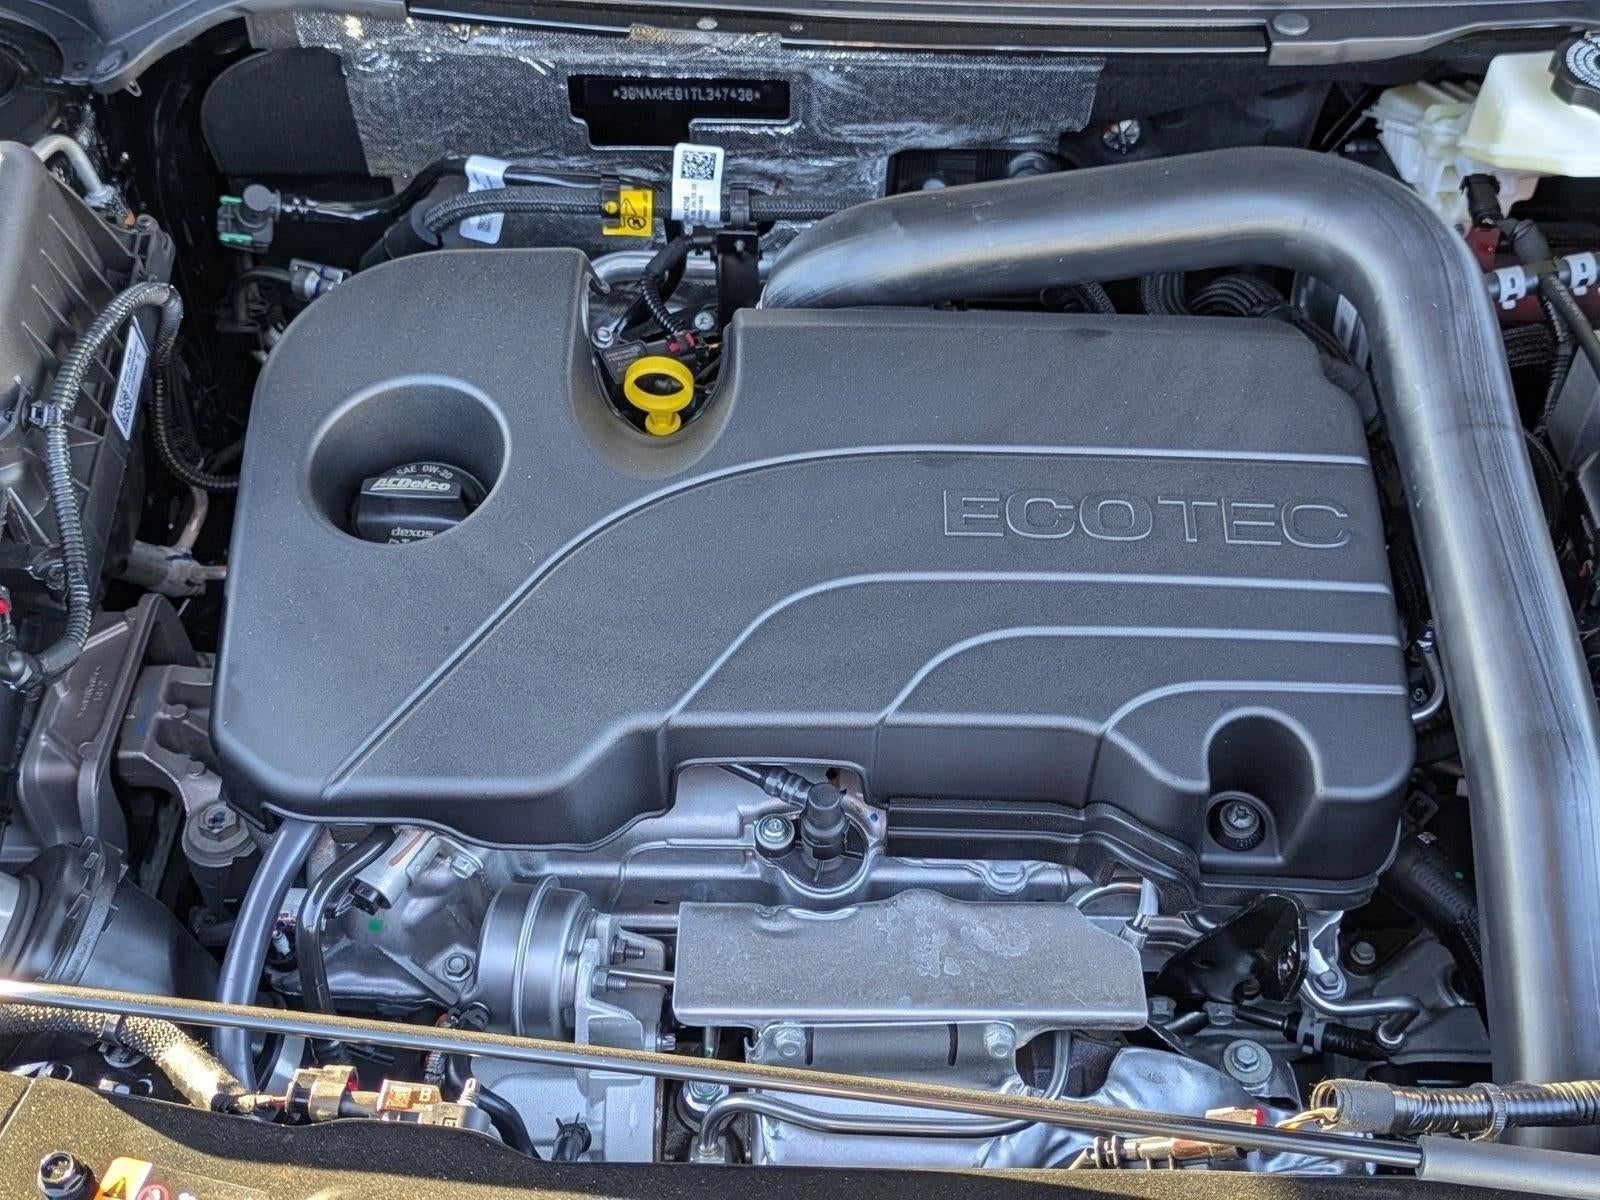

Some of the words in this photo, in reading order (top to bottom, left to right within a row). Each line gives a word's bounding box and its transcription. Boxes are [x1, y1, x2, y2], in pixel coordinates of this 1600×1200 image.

[395, 464, 417, 476] SAE
[421, 464, 454, 480] 0W-20
[370, 477, 452, 491] ACDelco
[942, 486, 1352, 549] ECOTEC
[389, 525, 435, 538] dexos
